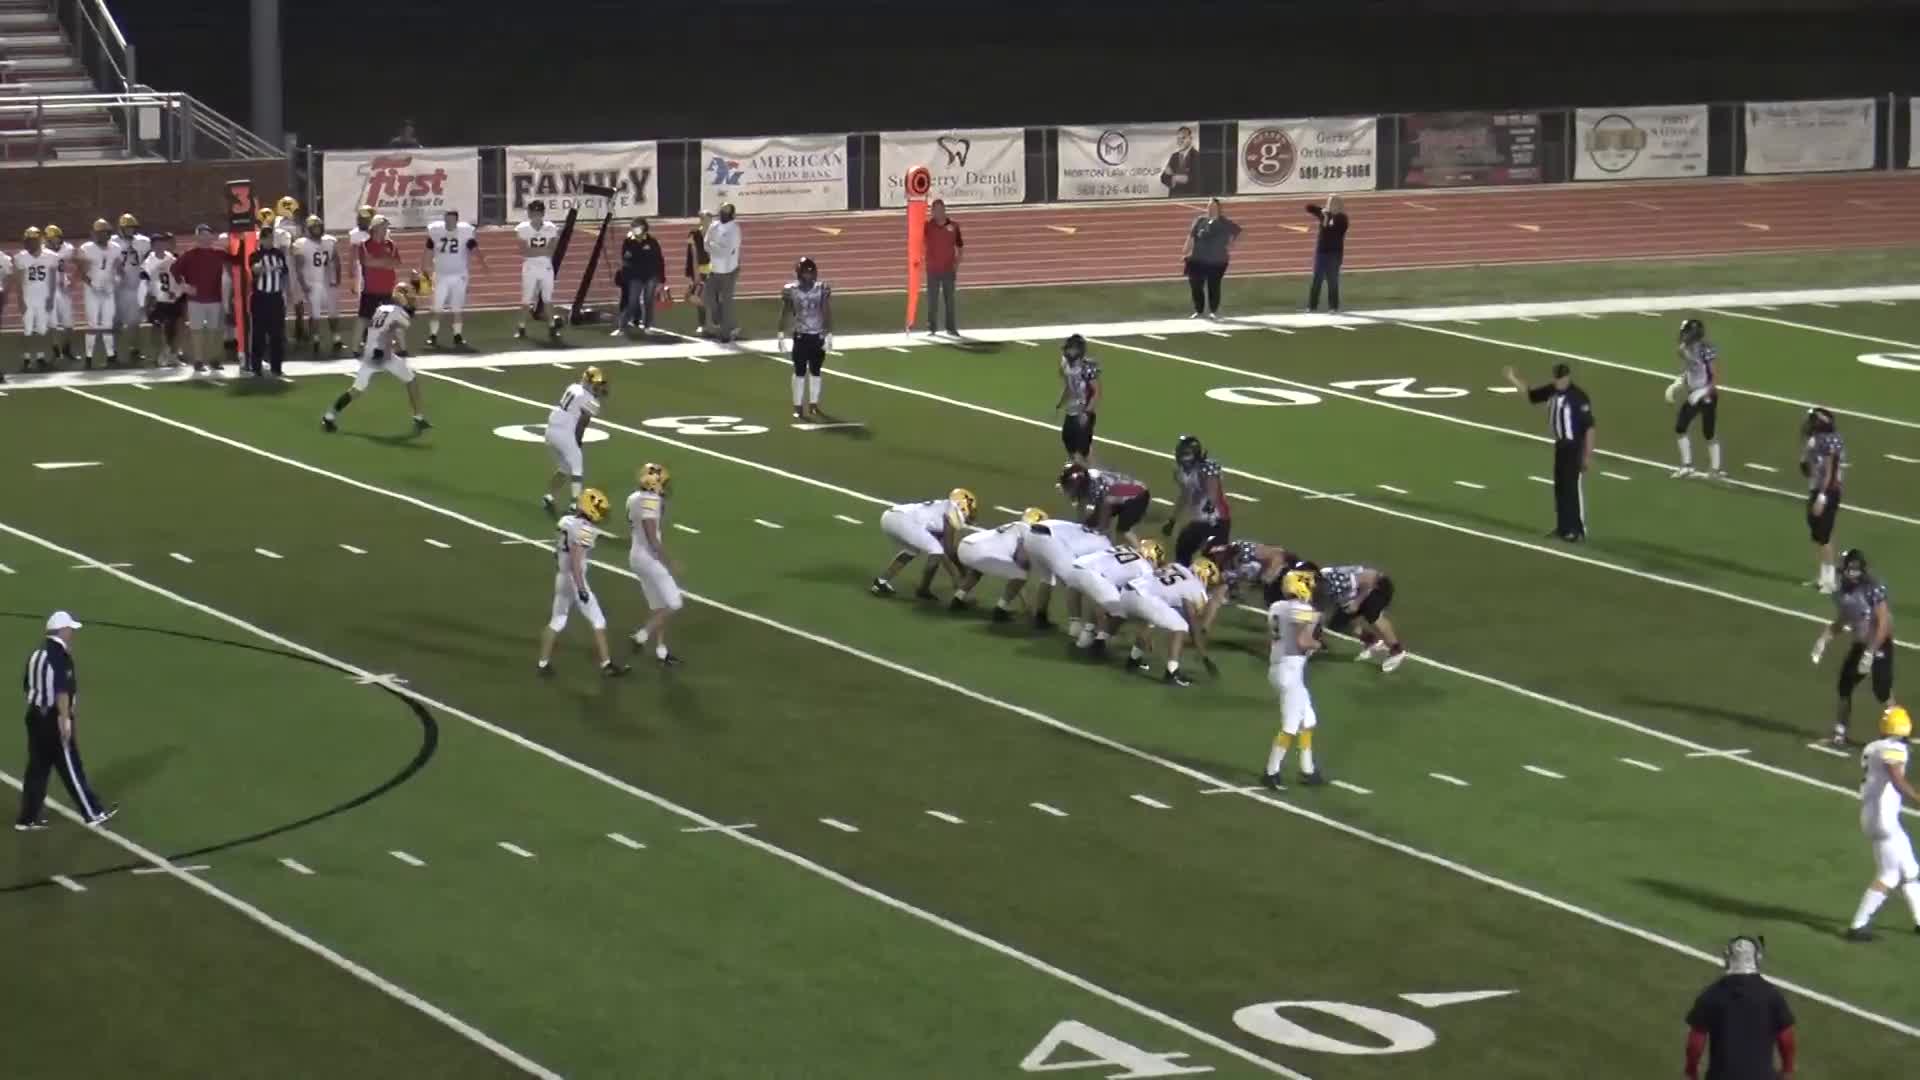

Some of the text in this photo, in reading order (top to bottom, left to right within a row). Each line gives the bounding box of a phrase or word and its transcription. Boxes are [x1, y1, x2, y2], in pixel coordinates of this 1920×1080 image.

[751, 153, 842, 169] AMERICAN
[965, 169, 1017, 186] Dental
[511, 168, 651, 210] FAMILY
[231, 186, 251, 214] 3
[439, 237, 458, 253] 72
[28, 265, 47, 282] 25
